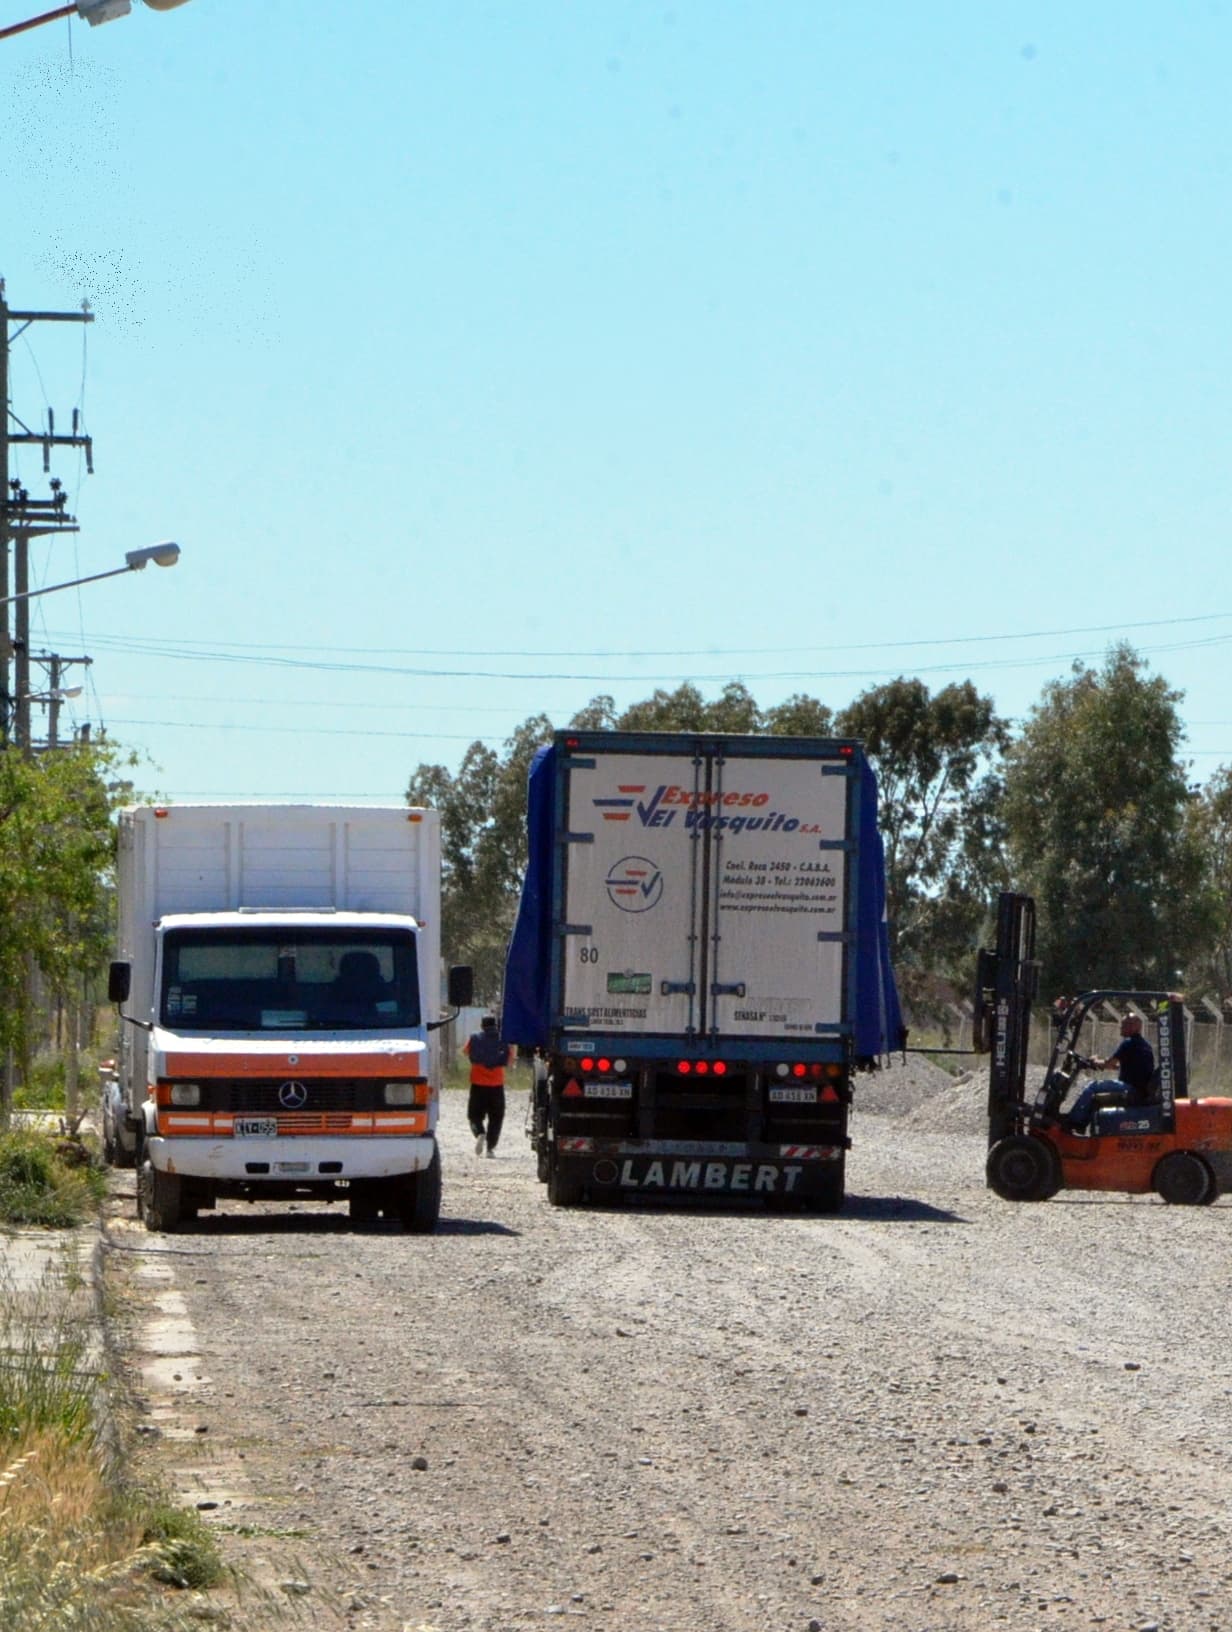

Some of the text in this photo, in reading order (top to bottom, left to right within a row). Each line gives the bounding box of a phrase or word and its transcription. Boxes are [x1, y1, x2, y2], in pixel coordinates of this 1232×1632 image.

[661, 786, 770, 810] Expreso
[649, 809, 677, 828] El
[684, 811, 800, 834] Vasquito
[580, 947, 599, 964] 80
[620, 1160, 803, 1192] LAMBERT
